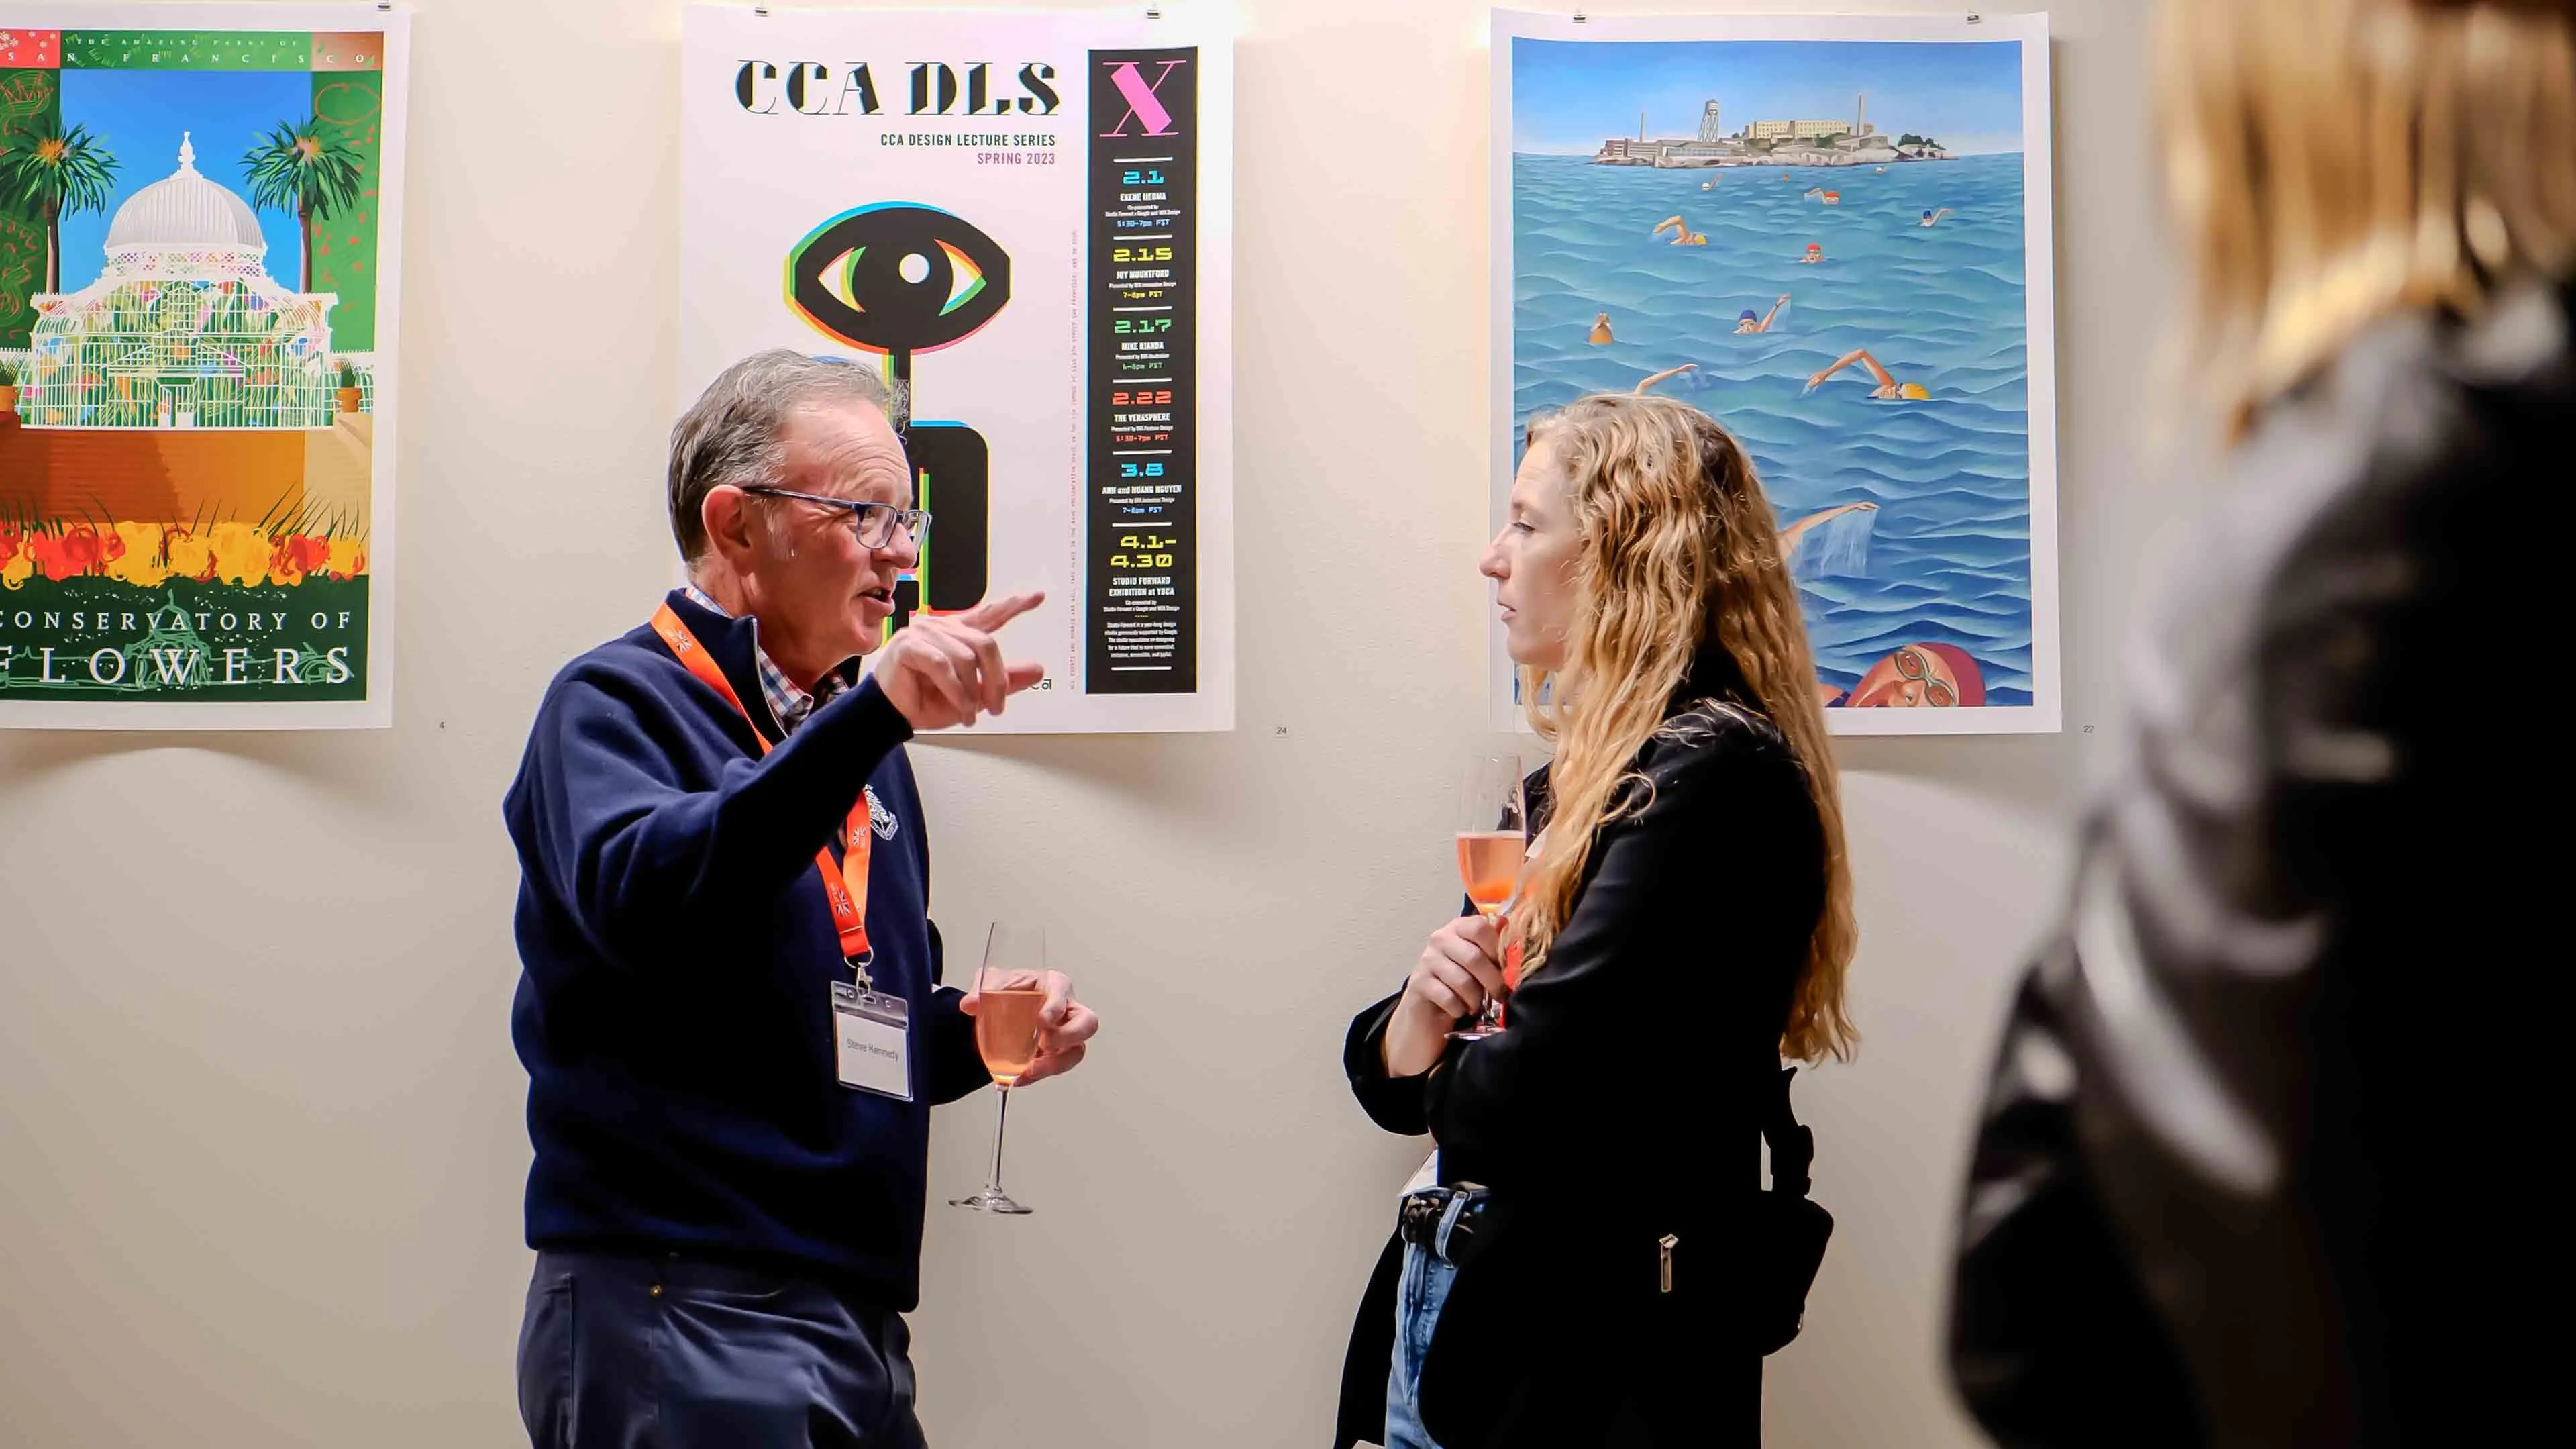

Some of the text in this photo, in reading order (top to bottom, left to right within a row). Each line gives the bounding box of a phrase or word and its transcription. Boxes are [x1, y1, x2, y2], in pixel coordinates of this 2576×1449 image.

[8, 52, 364, 64] SAN FRANCISCO
[735, 59, 1060, 116] CCA DLS
[1099, 59, 1187, 138] X
[880, 134, 1055, 146] CCA DESIGN LECTURE SERIES
[977, 152, 1055, 165] SPRING 2023
[1123, 170, 1164, 185] 2.1
[1113, 247, 1172, 262] 2.15
[1116, 270, 1129, 279] JOY
[1149, 290, 1163, 298] PST
[1114, 319, 1172, 334] 2.17
[1121, 342, 1139, 350] MIKE
[1113, 391, 1172, 405] 2.22
[1114, 413, 1171, 422] THE VERASPHERE
[1121, 462, 1164, 477] 3.8
[1102, 484, 1182, 495] ANH and HOANG NGUYEN
[1120, 535, 1177, 549] 4.1-
[1111, 554, 1172, 568] 4.30
[1113, 576, 1170, 586] STUDIO FORWARD
[1109, 588, 1147, 597] EXHIBITION
[1157, 587, 1175, 596] YBCA
[0, 611, 350, 630] ONSERVATORY OF
[439, 721, 445, 730] 4
[1277, 726, 1287, 735] 24
